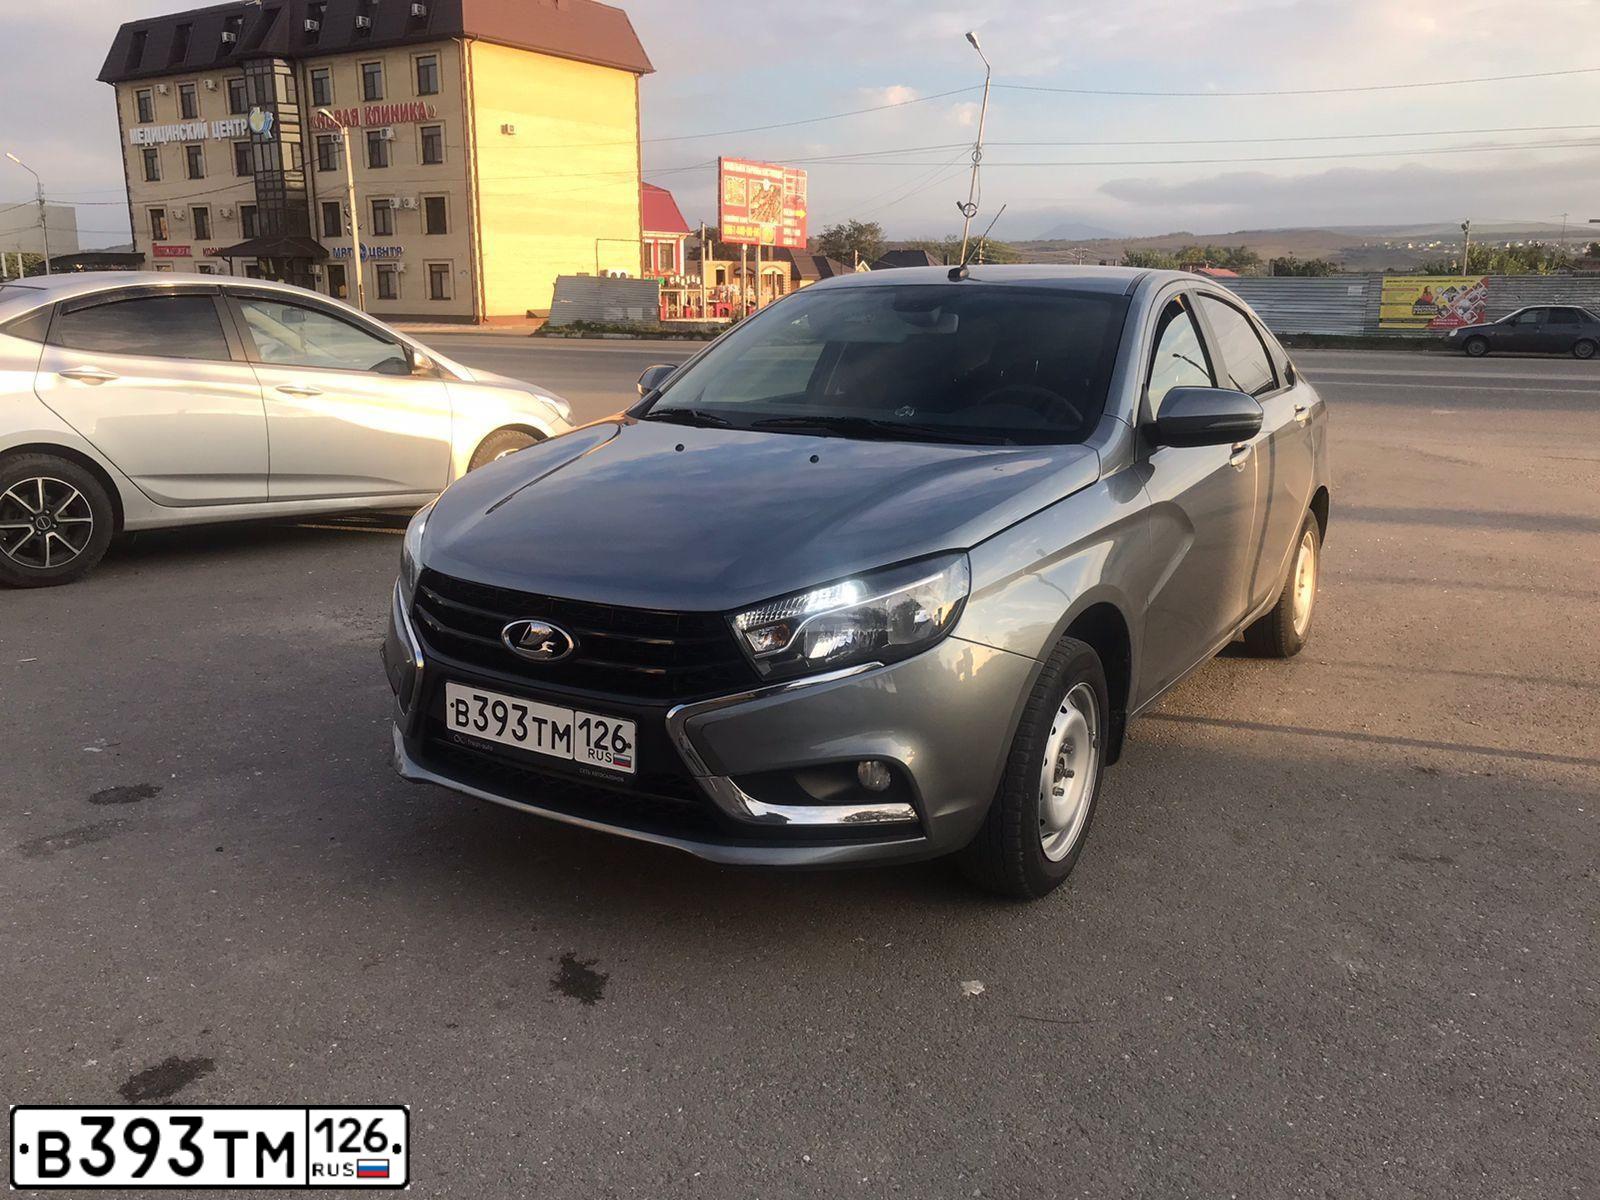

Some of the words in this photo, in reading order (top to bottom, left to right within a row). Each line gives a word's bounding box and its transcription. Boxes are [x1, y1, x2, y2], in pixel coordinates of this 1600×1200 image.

[129, 119, 208, 146] МЕДИЦИНСКИЙ
[211, 119, 248, 141] ЦЕНТР
[455, 694, 572, 753] В393ТМ
[578, 717, 627, 753] 126
[588, 748, 612, 763] RUS
